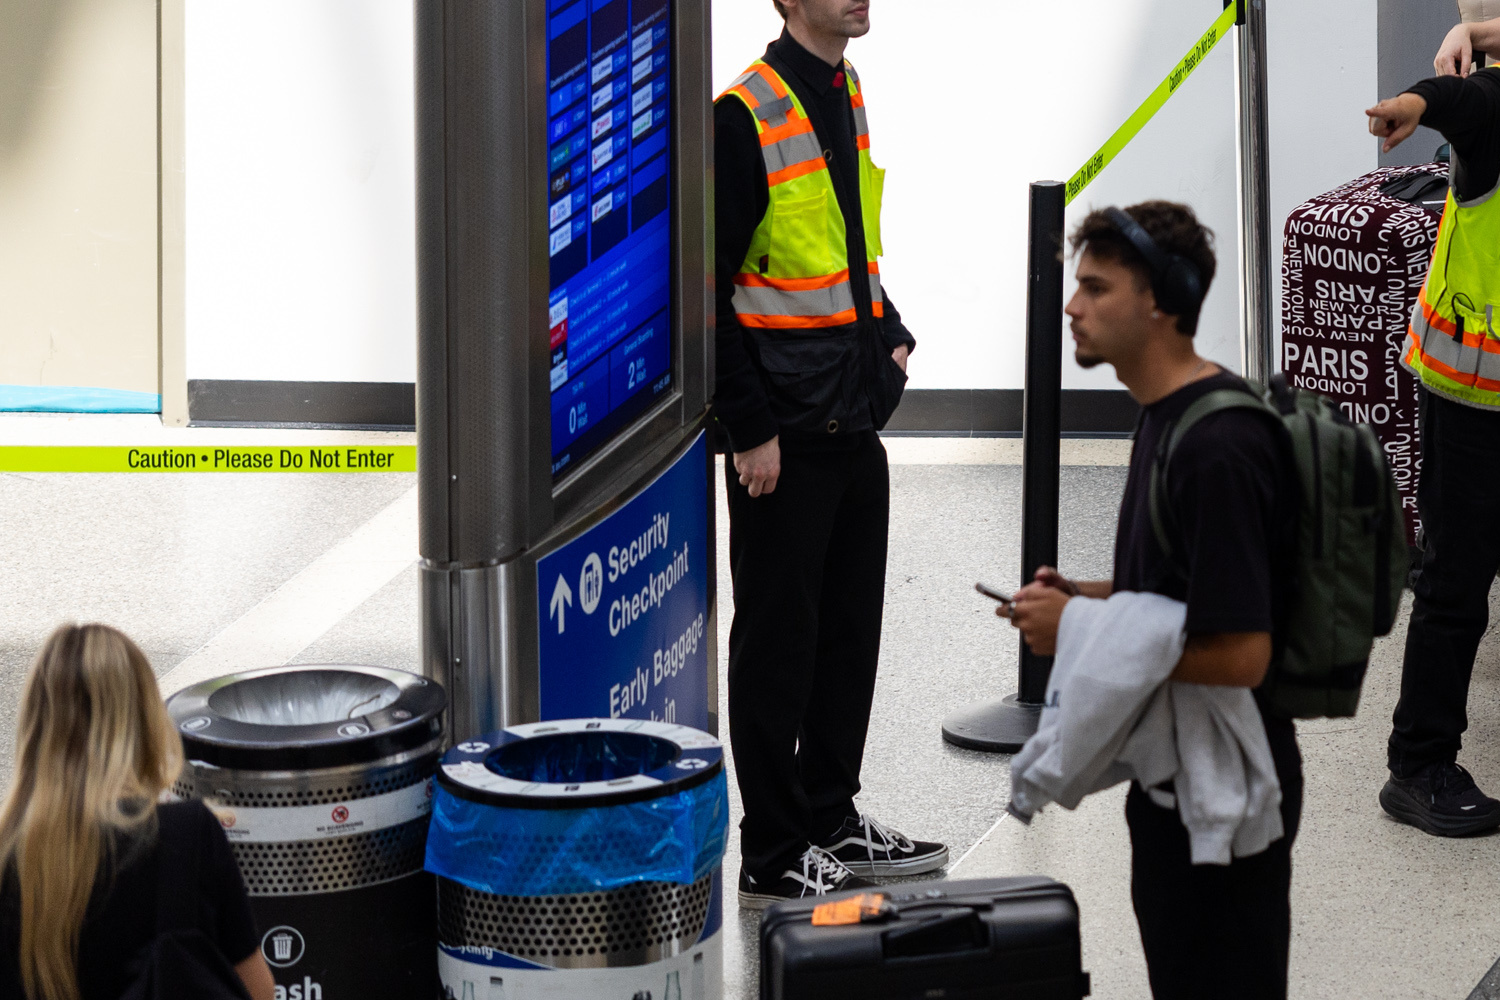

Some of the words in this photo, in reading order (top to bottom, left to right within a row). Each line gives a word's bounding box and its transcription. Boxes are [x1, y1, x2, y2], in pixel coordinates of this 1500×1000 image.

[1169, 68, 1183, 93] Caution
[1184, 52, 1196, 76] Please
[1195, 45, 1201, 63] Do
[1207, 28, 1217, 50] Enter
[1068, 176, 1081, 200] Please
[1081, 169, 1086, 187] Do
[1086, 160, 1094, 181] Not
[1094, 153, 1104, 174] Enter
[1287, 202, 1375, 228] PARIS
[1289, 219, 1362, 244] LONDON
[1289, 248, 1303, 284] NEW
[1303, 243, 1381, 275] ONDON
[1309, 299, 1344, 313] NEW
[1349, 303, 1390, 316] YOR
[1313, 310, 1383, 331] PARIS
[1330, 330, 1375, 343] NEW
[1283, 341, 1369, 381] PARIS
[628, 361, 636, 390] 2
[1294, 374, 1367, 396] LONDON
[569, 406, 577, 434] 0
[128, 448, 196, 469] Caution
[214, 449, 273, 469] Please
[280, 449, 304, 469] Do
[310, 449, 340, 469] Not
[346, 449, 395, 469] Enter
[608, 511, 670, 583] Security
[608, 541, 689, 638] Checkpoint
[610, 666, 650, 720] Early
[653, 611, 704, 687] Baggage
[274, 975, 323, 1000] ash
